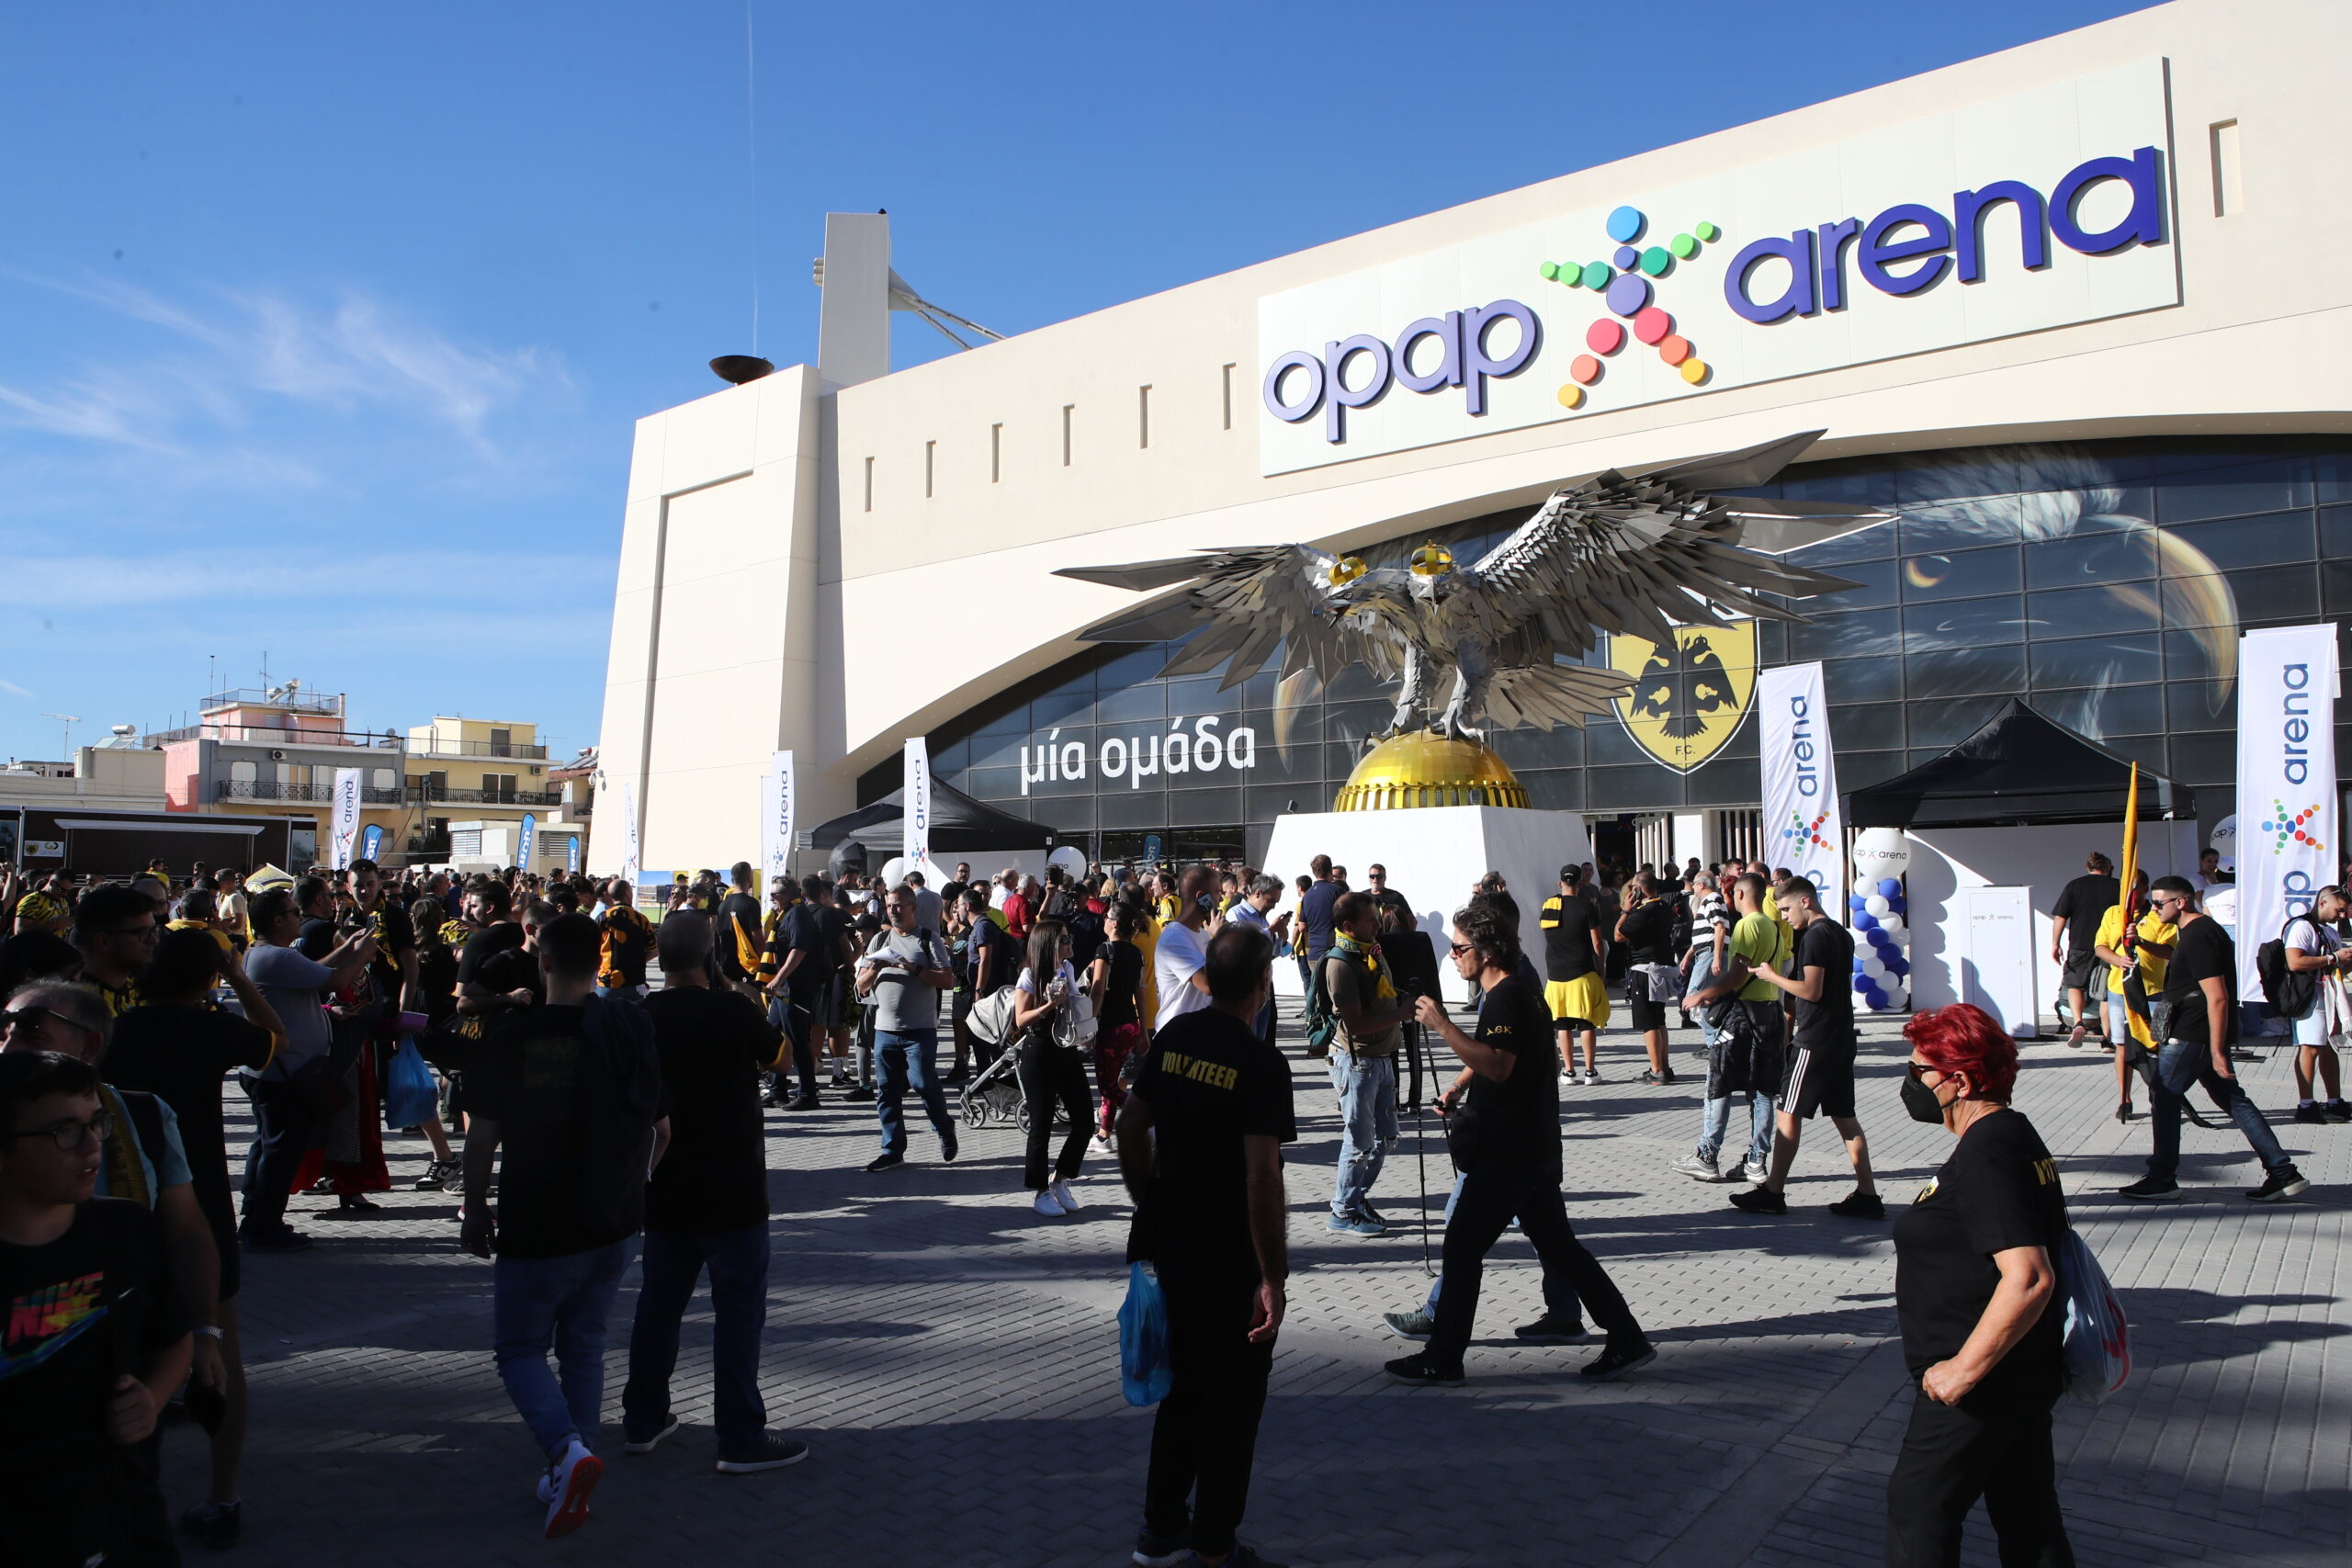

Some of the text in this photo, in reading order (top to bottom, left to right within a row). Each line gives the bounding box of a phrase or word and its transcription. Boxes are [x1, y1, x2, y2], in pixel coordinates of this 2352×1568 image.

[1262, 145, 2166, 443] opap arena
[1021, 716, 1256, 795] μία ομάδα
[1675, 744, 1696, 755] F.C.
[1791, 695, 1817, 796] arena
[345, 781, 355, 823] arena
[780, 771, 788, 835] arena
[916, 760, 926, 829] arena
[2283, 663, 2318, 919] ap arena
[6, 1270, 104, 1346] NIKE
